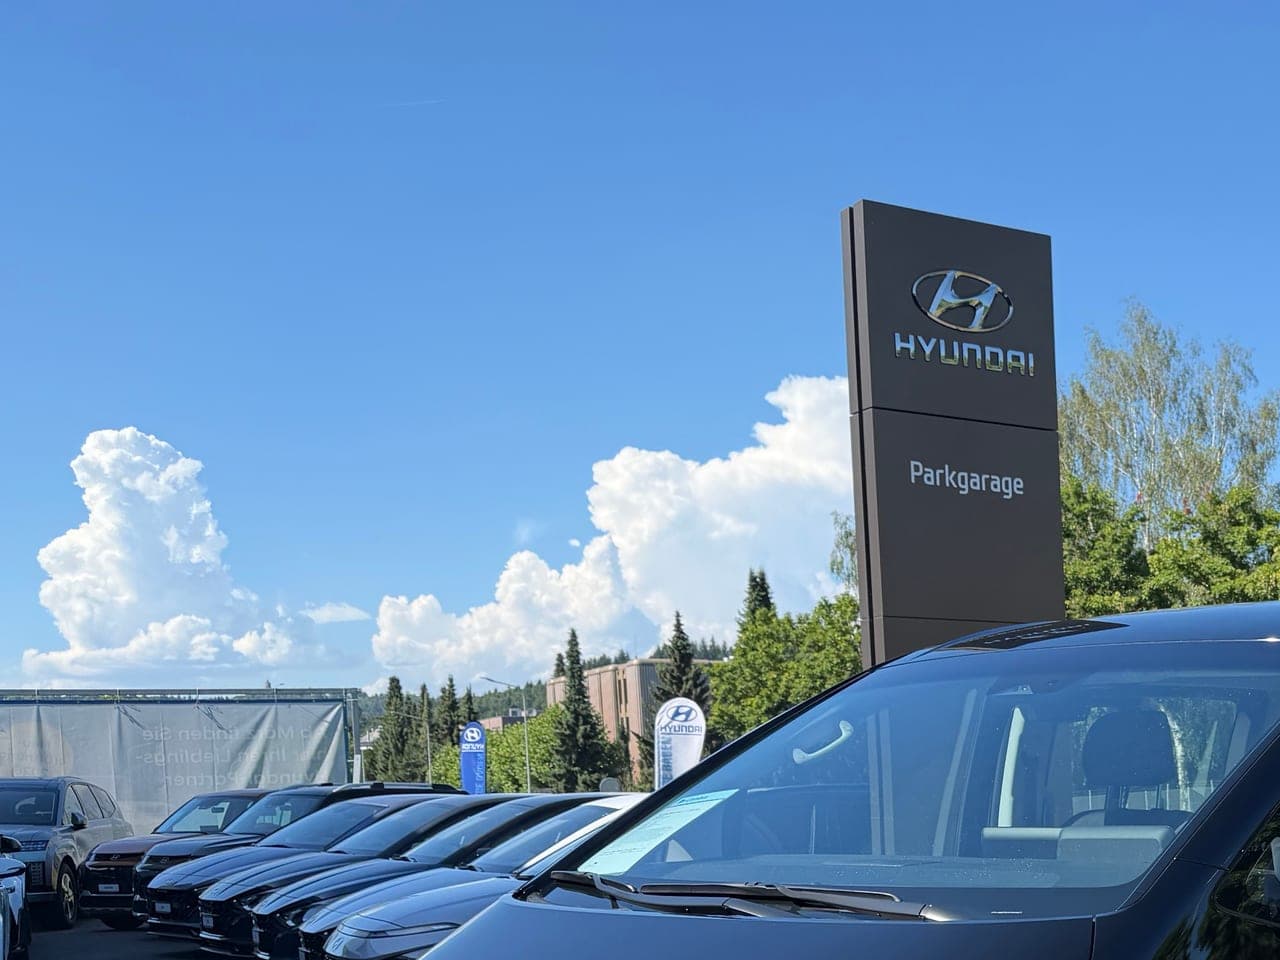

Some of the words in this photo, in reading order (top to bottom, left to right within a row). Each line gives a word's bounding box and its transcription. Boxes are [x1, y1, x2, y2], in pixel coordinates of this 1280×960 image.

[894, 331, 1035, 377] HYUNDAI
[909, 459, 1025, 500] Parkgarage
[660, 725, 703, 733] HYUNDAI
